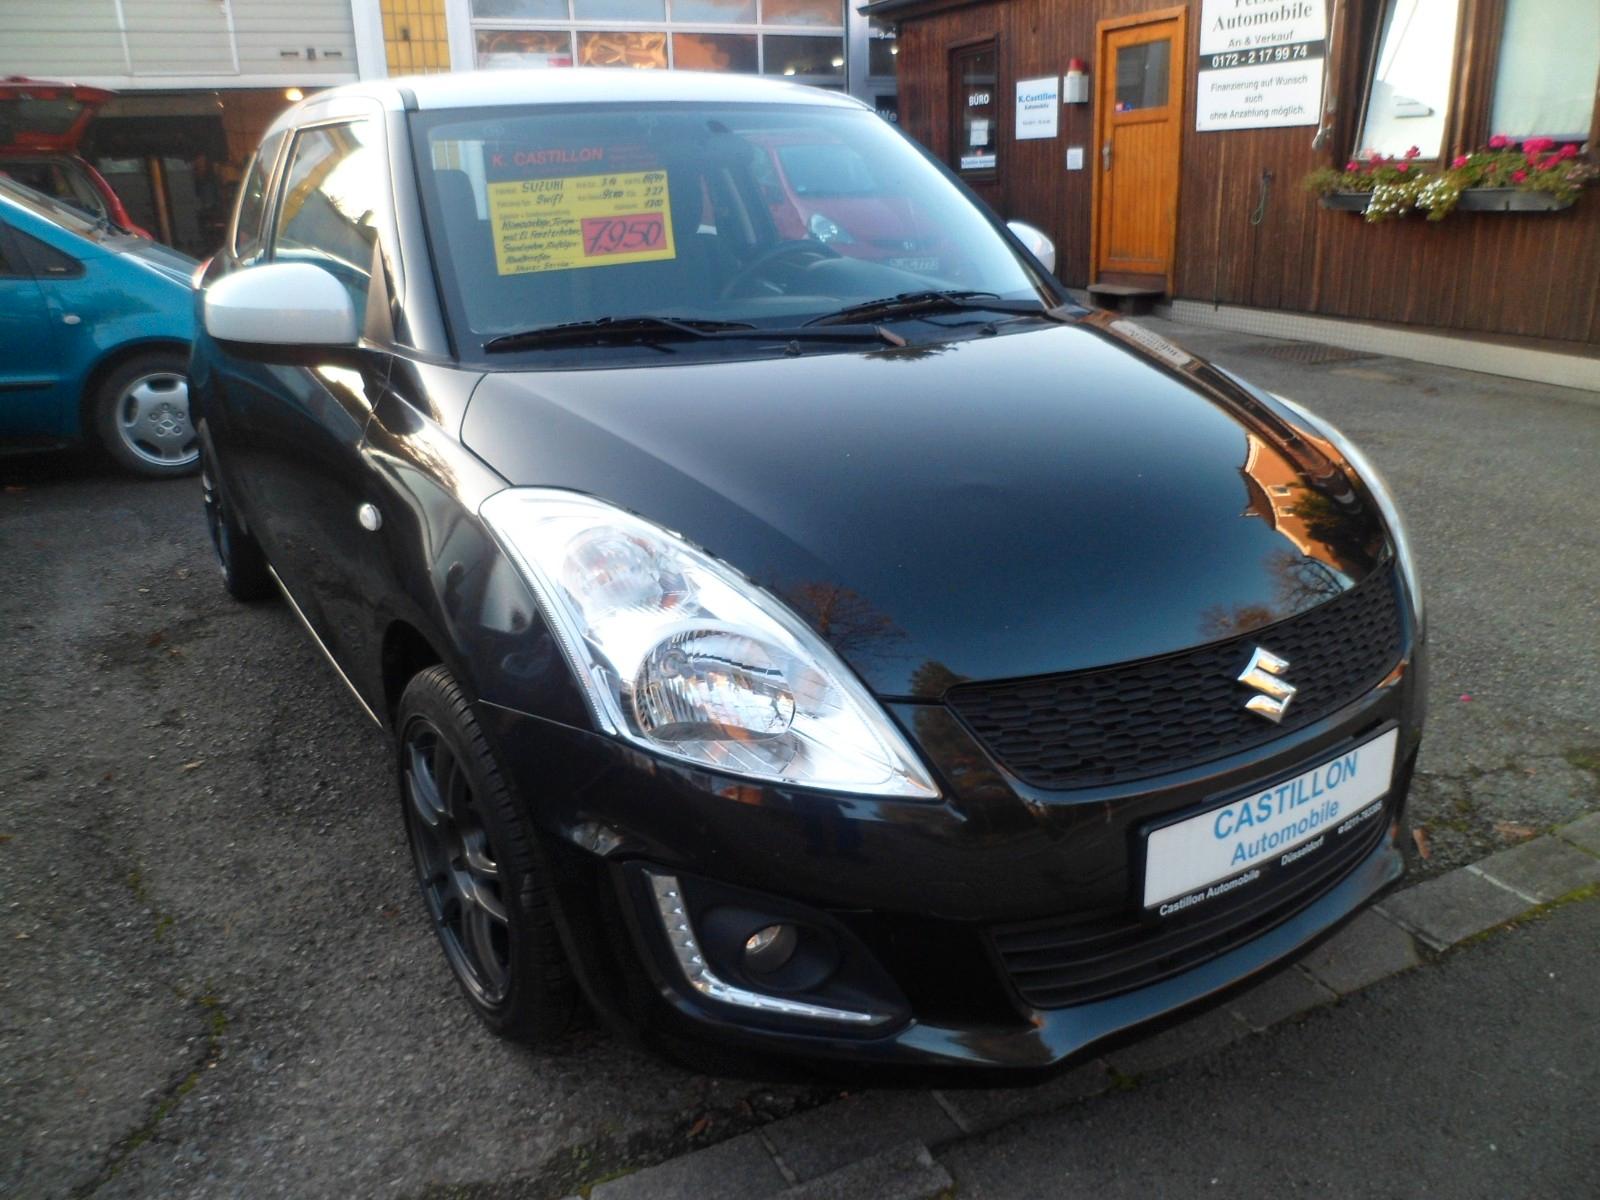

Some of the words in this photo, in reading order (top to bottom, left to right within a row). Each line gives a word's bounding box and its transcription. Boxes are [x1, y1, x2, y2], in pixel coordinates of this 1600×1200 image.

[1212, 3, 1313, 31] Automobile
[1228, 39, 1241, 48] An
[1244, 37, 1252, 46] &
[1254, 30, 1294, 44] Verkauf
[1211, 53, 1239, 68] 0172
[1247, 51, 1255, 64] 2
[1259, 49, 1273, 62] 17
[1274, 47, 1290, 60] 99
[1293, 45, 1308, 58] 74
[1210, 80, 1259, 92] Finanzierung
[1260, 78, 1274, 88] auf
[1275, 75, 1308, 87] Wunsch
[968, 92, 990, 107] BÜRO
[1244, 94, 1263, 103] auch
[1209, 111, 1228, 121] ohne
[1229, 107, 1269, 119] Anzahlung
[512, 147, 604, 166] CASTILLON
[522, 180, 564, 192] SUZUKI
[536, 193, 564, 207] Swift
[1213, 751, 1357, 839] CASTILLON
[1230, 800, 1339, 867] Automobile
[1159, 892, 1204, 916] Castillon
[1206, 869, 1261, 899] Automobile
